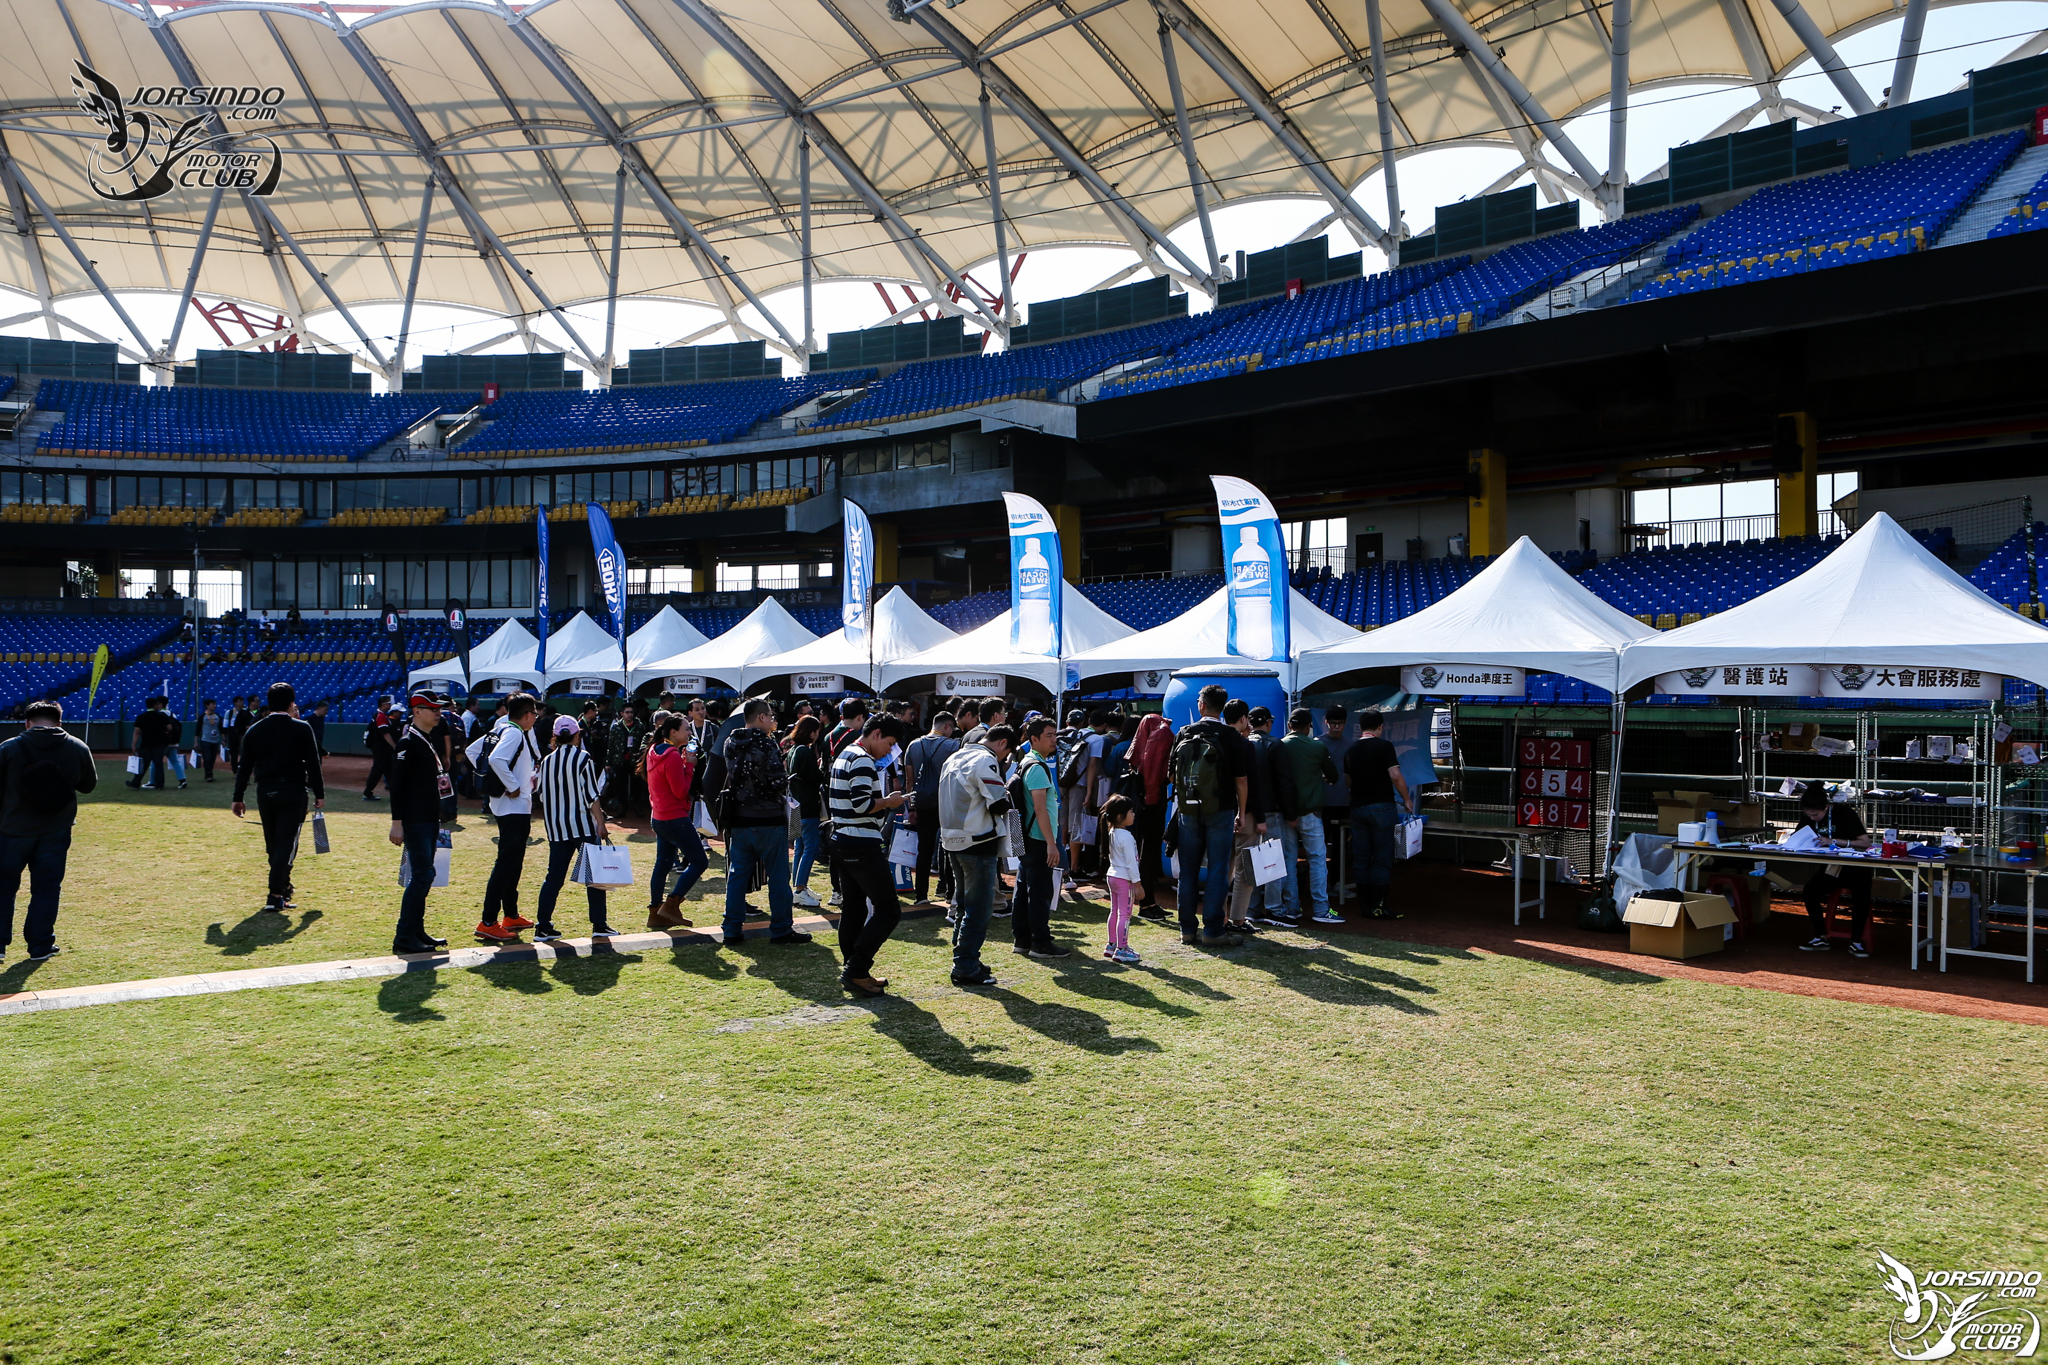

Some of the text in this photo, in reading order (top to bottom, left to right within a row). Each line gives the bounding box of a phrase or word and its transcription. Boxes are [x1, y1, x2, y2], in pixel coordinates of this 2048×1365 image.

[958, 678, 999, 688] Arai 台灣總代理
[1446, 672, 1513, 685] Honda準度王
[1722, 667, 1789, 686] 醫護站
[1876, 668, 1981, 688] 大會服務處
[1525, 741, 1582, 763] 3 2 1
[1525, 771, 1583, 793] 6 5 4
[1523, 802, 1583, 823] 9 8 7
